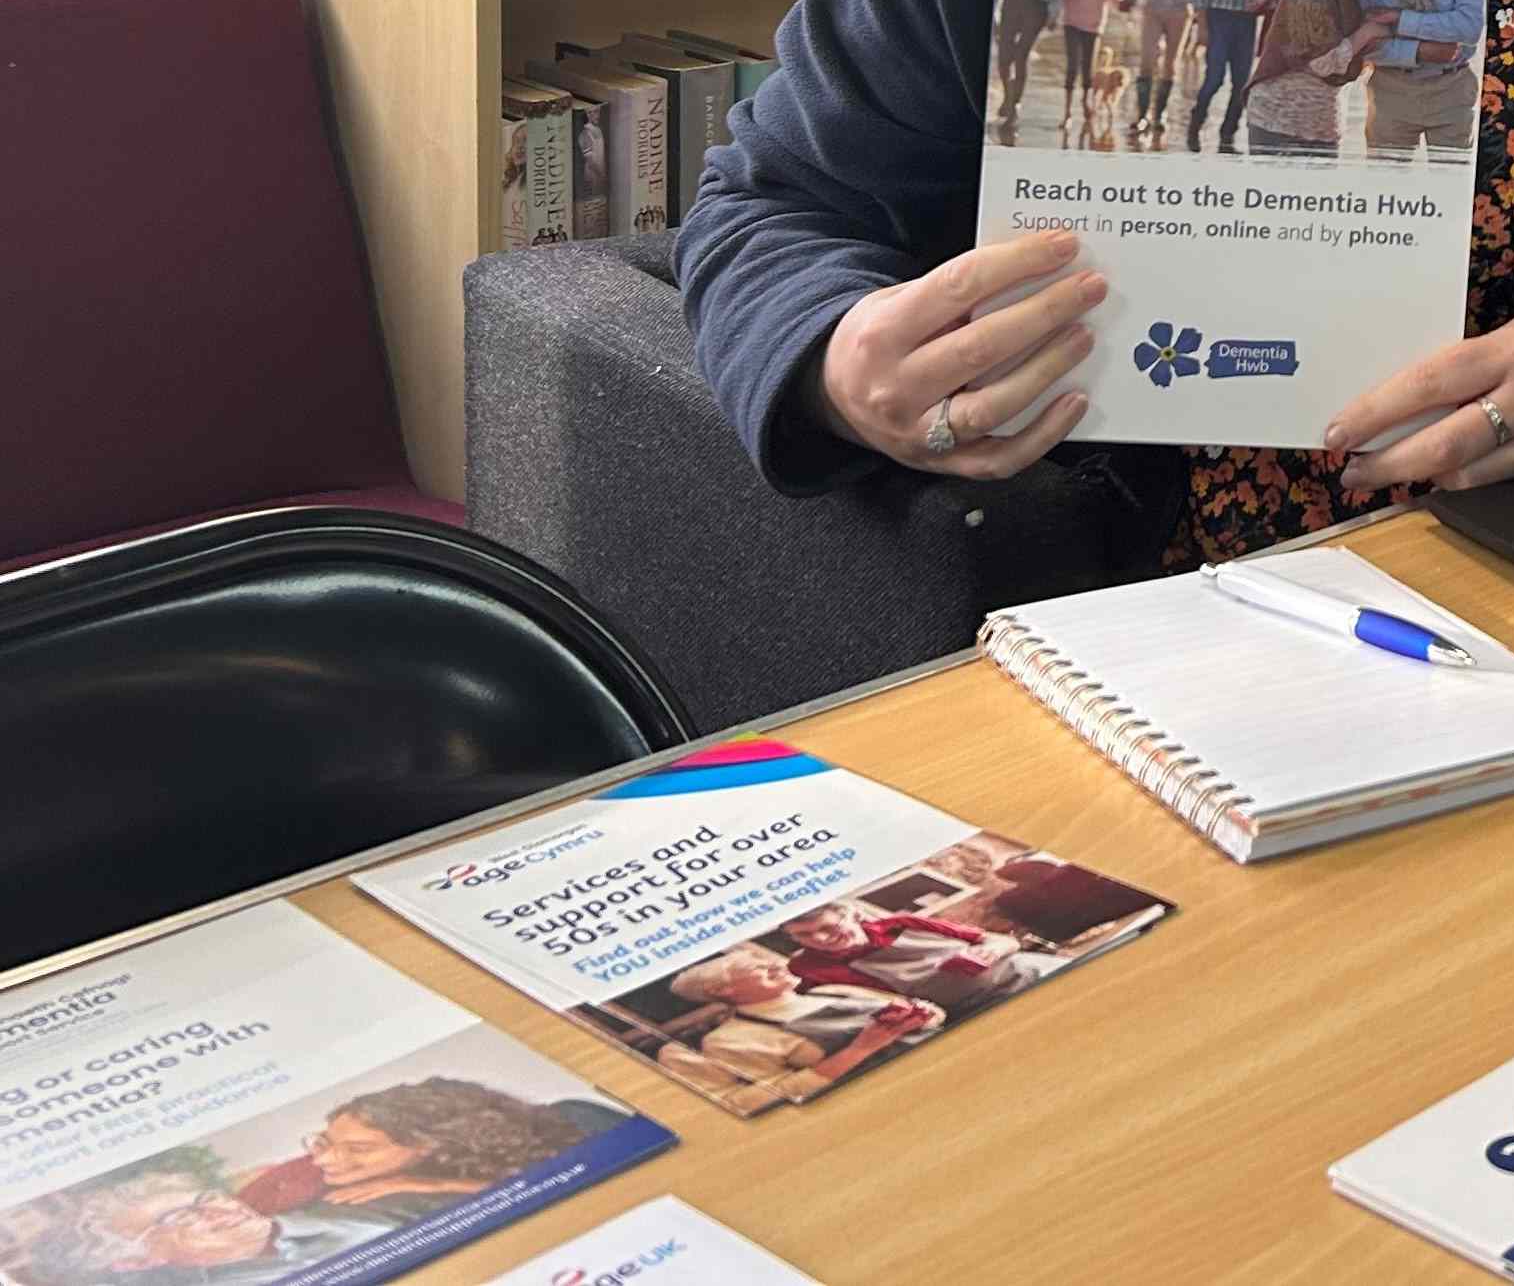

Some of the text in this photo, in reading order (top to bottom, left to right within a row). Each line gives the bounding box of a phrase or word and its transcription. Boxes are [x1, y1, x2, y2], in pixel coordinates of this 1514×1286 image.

[638, 119, 649, 179] DORRIES
[648, 98, 664, 194] NADINE
[534, 147, 546, 208] DORRIES
[1015, 178, 1444, 218] Reach out to the Dementia Hwb.
[1011, 212, 1420, 247] Support in person, online and by phone.
[1218, 343, 1289, 362] Dementia
[1235, 358, 1270, 374] Hwb
[463, 829, 605, 886] age Cymru
[484, 825, 722, 928] Services and
[516, 813, 805, 943] support for over
[543, 827, 840, 956] 50s in your area
[573, 846, 858, 975] Find out how we can help
[593, 867, 851, 984] YOU inside this leaflet
[35, 1021, 215, 1089] or caring
[185, 1021, 271, 1056] with
